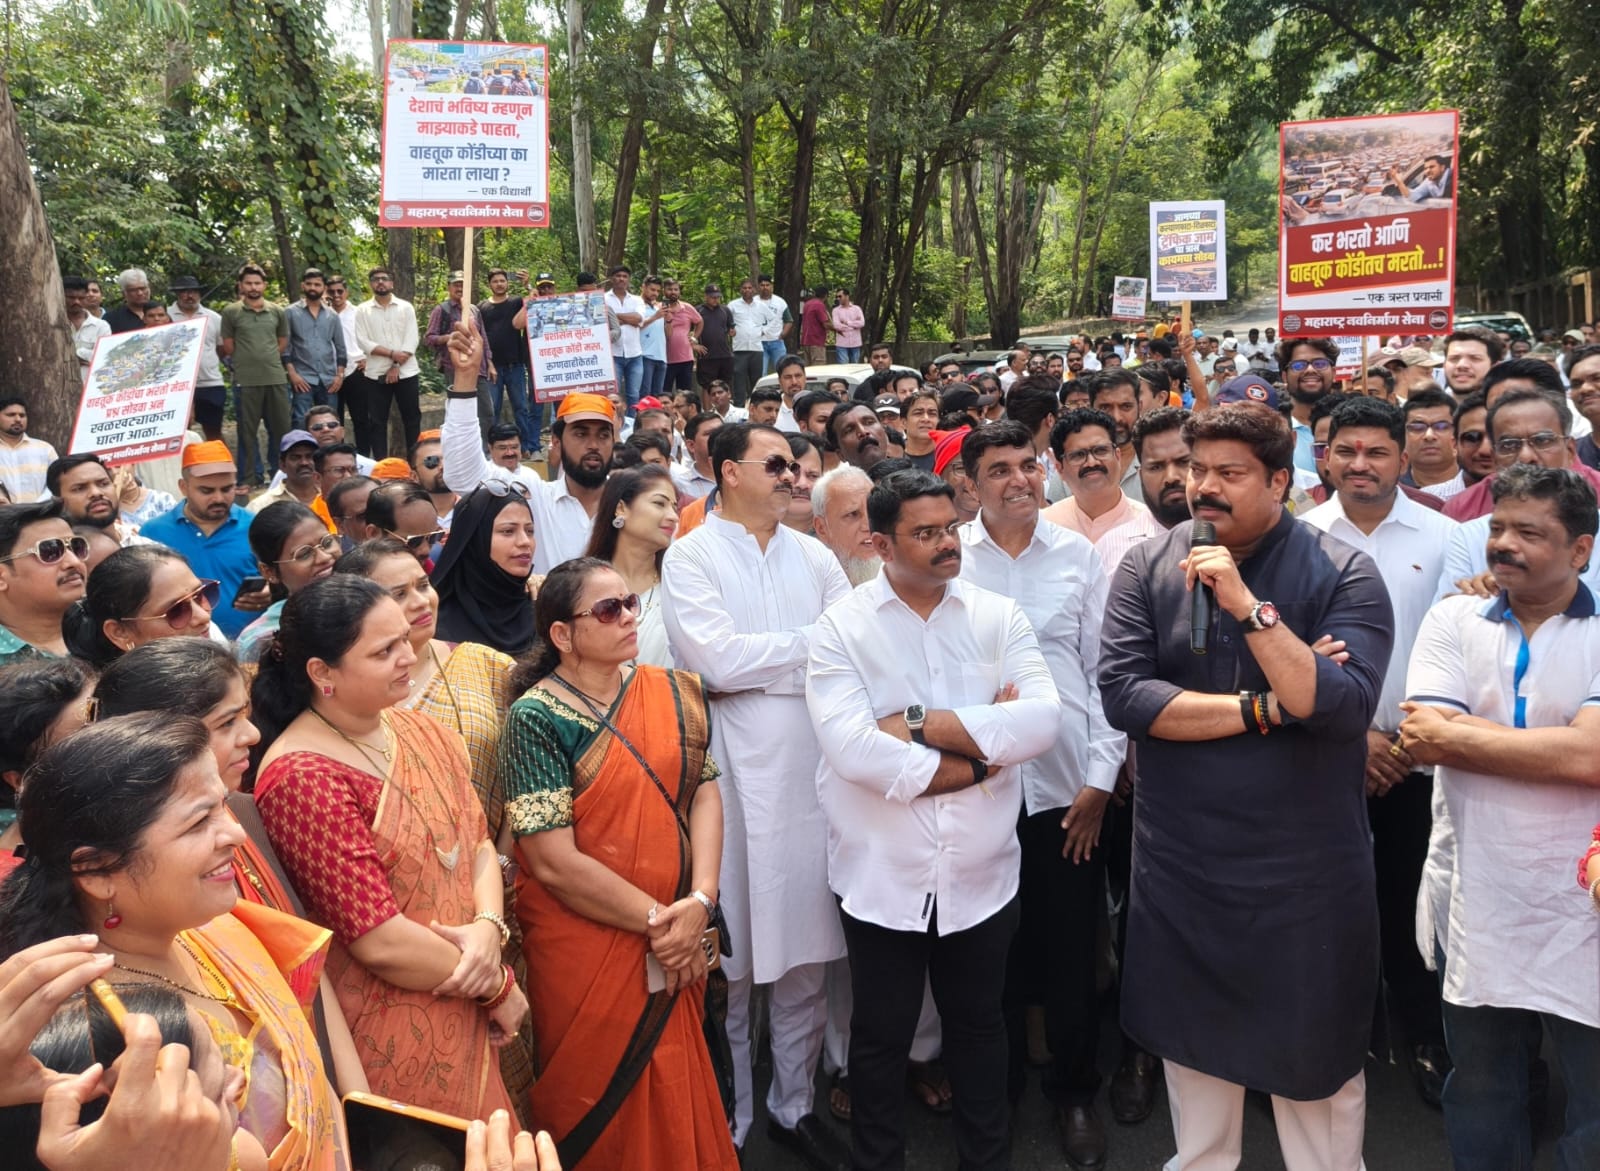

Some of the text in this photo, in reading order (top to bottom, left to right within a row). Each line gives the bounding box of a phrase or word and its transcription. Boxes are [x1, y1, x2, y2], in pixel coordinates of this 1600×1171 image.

[408, 97, 533, 121] देशाचं भविष्य म्हणून
[416, 119, 520, 139] माझ्याकडे पाहता,
[409, 143, 528, 164] वाहतूक कोंडीच्या का
[422, 167, 462, 181] मारता
[465, 167, 499, 182] लाथा
[481, 187, 498, 196] एक
[499, 186, 531, 197] विद्यार्थी
[407, 207, 448, 219] महाराष्ट्र
[449, 205, 500, 217] नवनिर्माण
[502, 205, 524, 218] सेना
[1195, 231, 1214, 243] जाम
[1311, 218, 1410, 253] कर भरतो आणि
[1289, 262, 1333, 287] वाहतूक
[1336, 251, 1384, 278] कोंडीतच
[1367, 293, 1385, 304] एक
[1388, 292, 1410, 303] त्रस्त
[1413, 288, 1444, 303] प्रवासी
[1304, 316, 1346, 329] महाराष्ट्र
[1346, 312, 1399, 326] नवनिर्माण
[1401, 311, 1425, 325] सेना
[538, 347, 564, 358] वाहतूक
[565, 342, 583, 354] कोंडी
[543, 373, 563, 384] मरण
[565, 369, 582, 382] झाले
[86, 395, 114, 409] वाहतूक
[146, 384, 169, 397] भरतो
[96, 431, 123, 445] घाला
